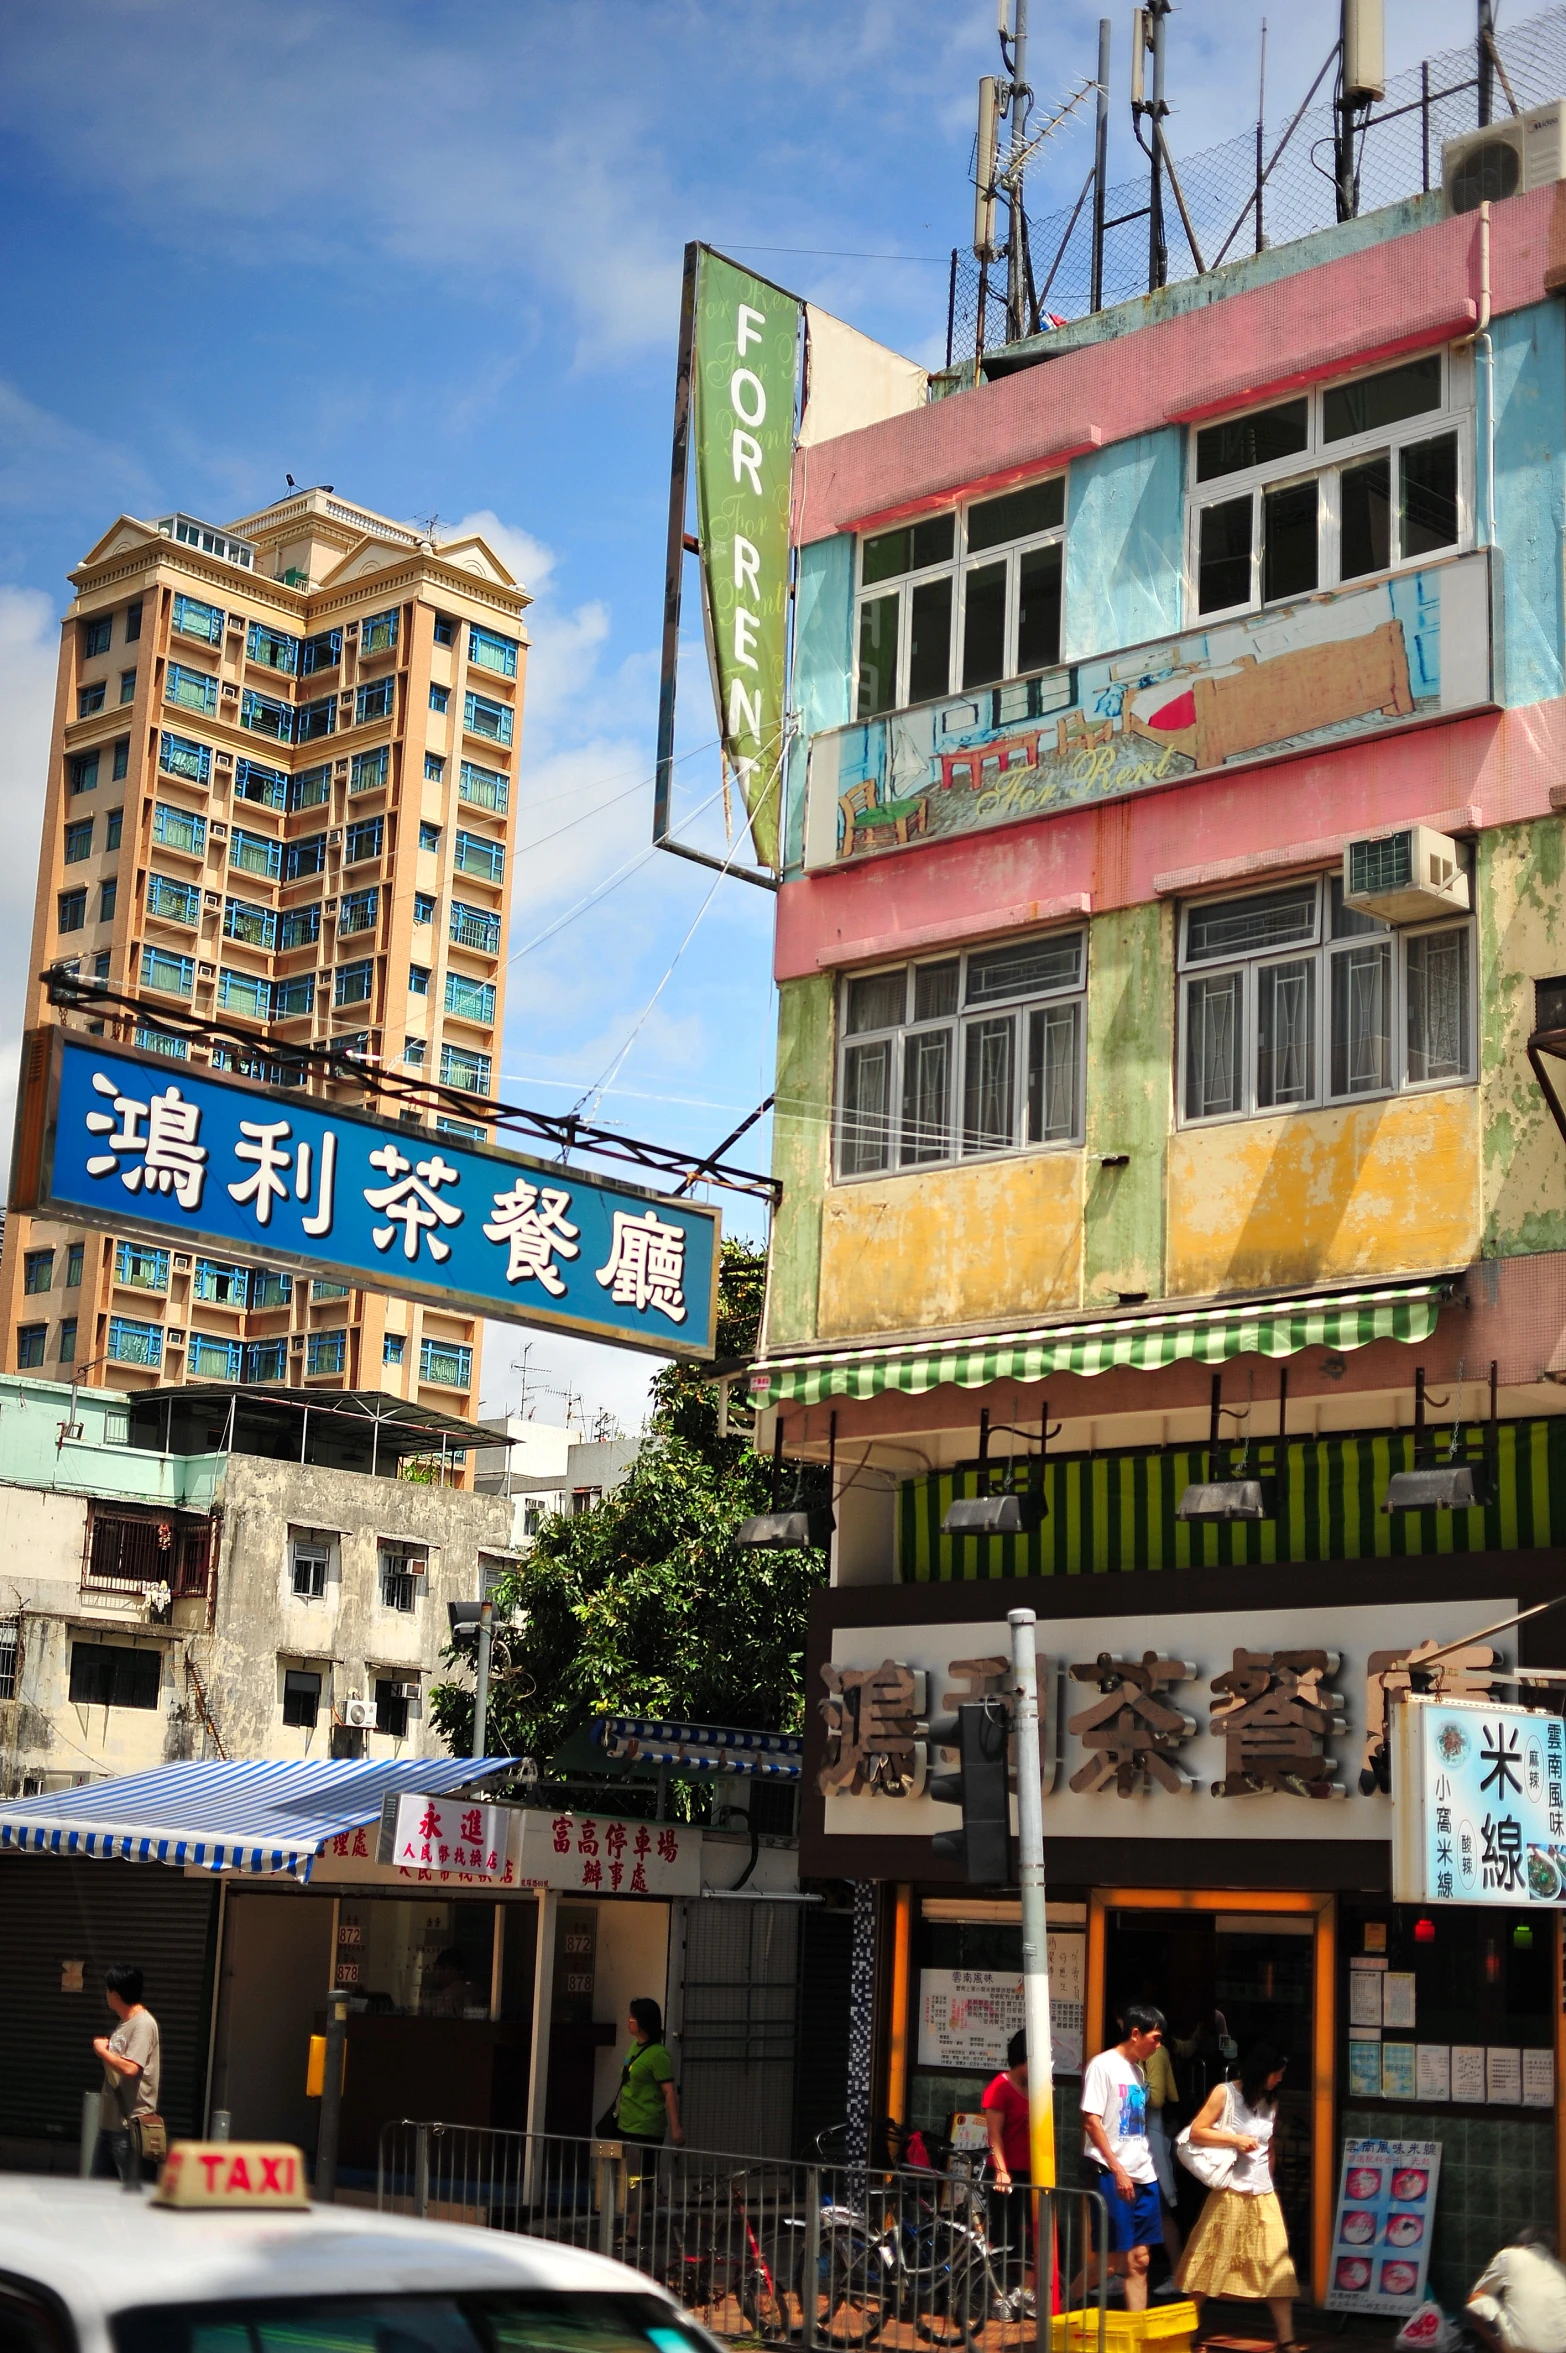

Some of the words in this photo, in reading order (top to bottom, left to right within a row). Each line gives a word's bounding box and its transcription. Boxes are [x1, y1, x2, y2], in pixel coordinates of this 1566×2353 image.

[731, 303, 766, 496] FOR
[976, 763, 1058, 816] For
[1069, 743, 1177, 798] Rent
[86, 1072, 687, 1324] 鴻利茶餐廳
[816, 1639, 1501, 1800] 鴻茶餐
[1529, 1750, 1541, 1790] 麻辣
[1547, 1723, 1565, 1838] 雲南風味
[418, 1802, 484, 1846] 永進
[1480, 1722, 1527, 1892] 米線
[402, 1842, 499, 1871] 人民幣找換店
[551, 1816, 679, 1863] 富高停車場
[1436, 1773, 1454, 1899] 小窩米線
[1461, 1834, 1474, 1876] 酸辣
[581, 1859, 650, 1894] 辦事處
[339, 1928, 361, 1943] 872
[567, 1936, 591, 1952] 872
[337, 1966, 358, 1981] 878
[568, 1975, 593, 1991] 878
[1346, 2139, 1437, 2156] 雲南風味米線
[197, 2154, 297, 2195] TAXI
